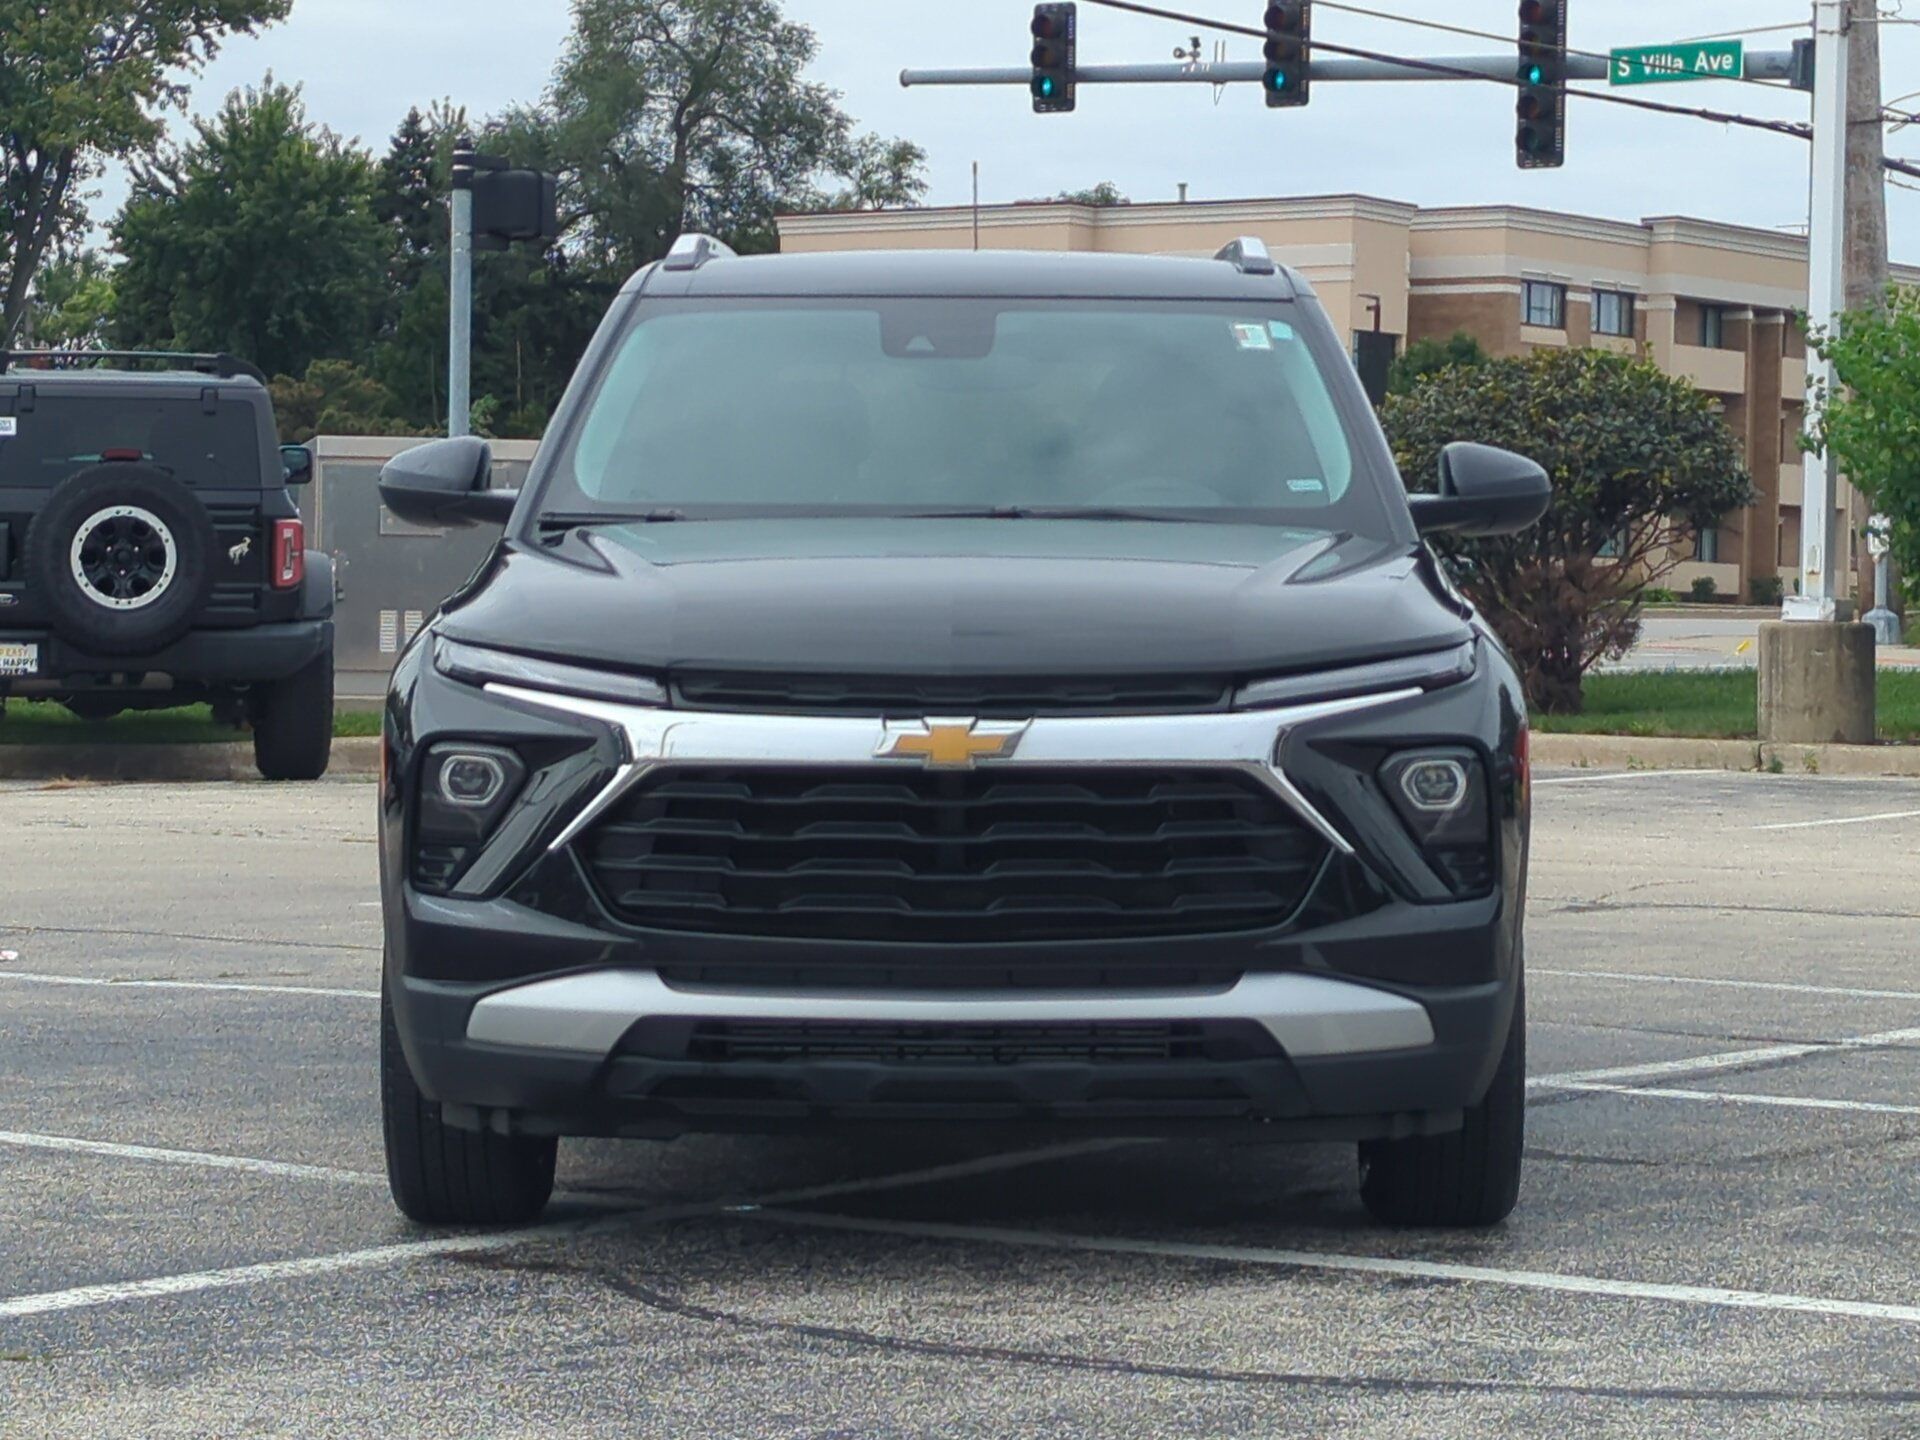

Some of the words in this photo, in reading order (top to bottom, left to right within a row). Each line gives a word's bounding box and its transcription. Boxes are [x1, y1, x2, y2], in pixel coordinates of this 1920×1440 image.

[1618, 56, 1630, 77] S
[1641, 52, 1684, 75] Villa
[1694, 51, 1733, 72] Ave
